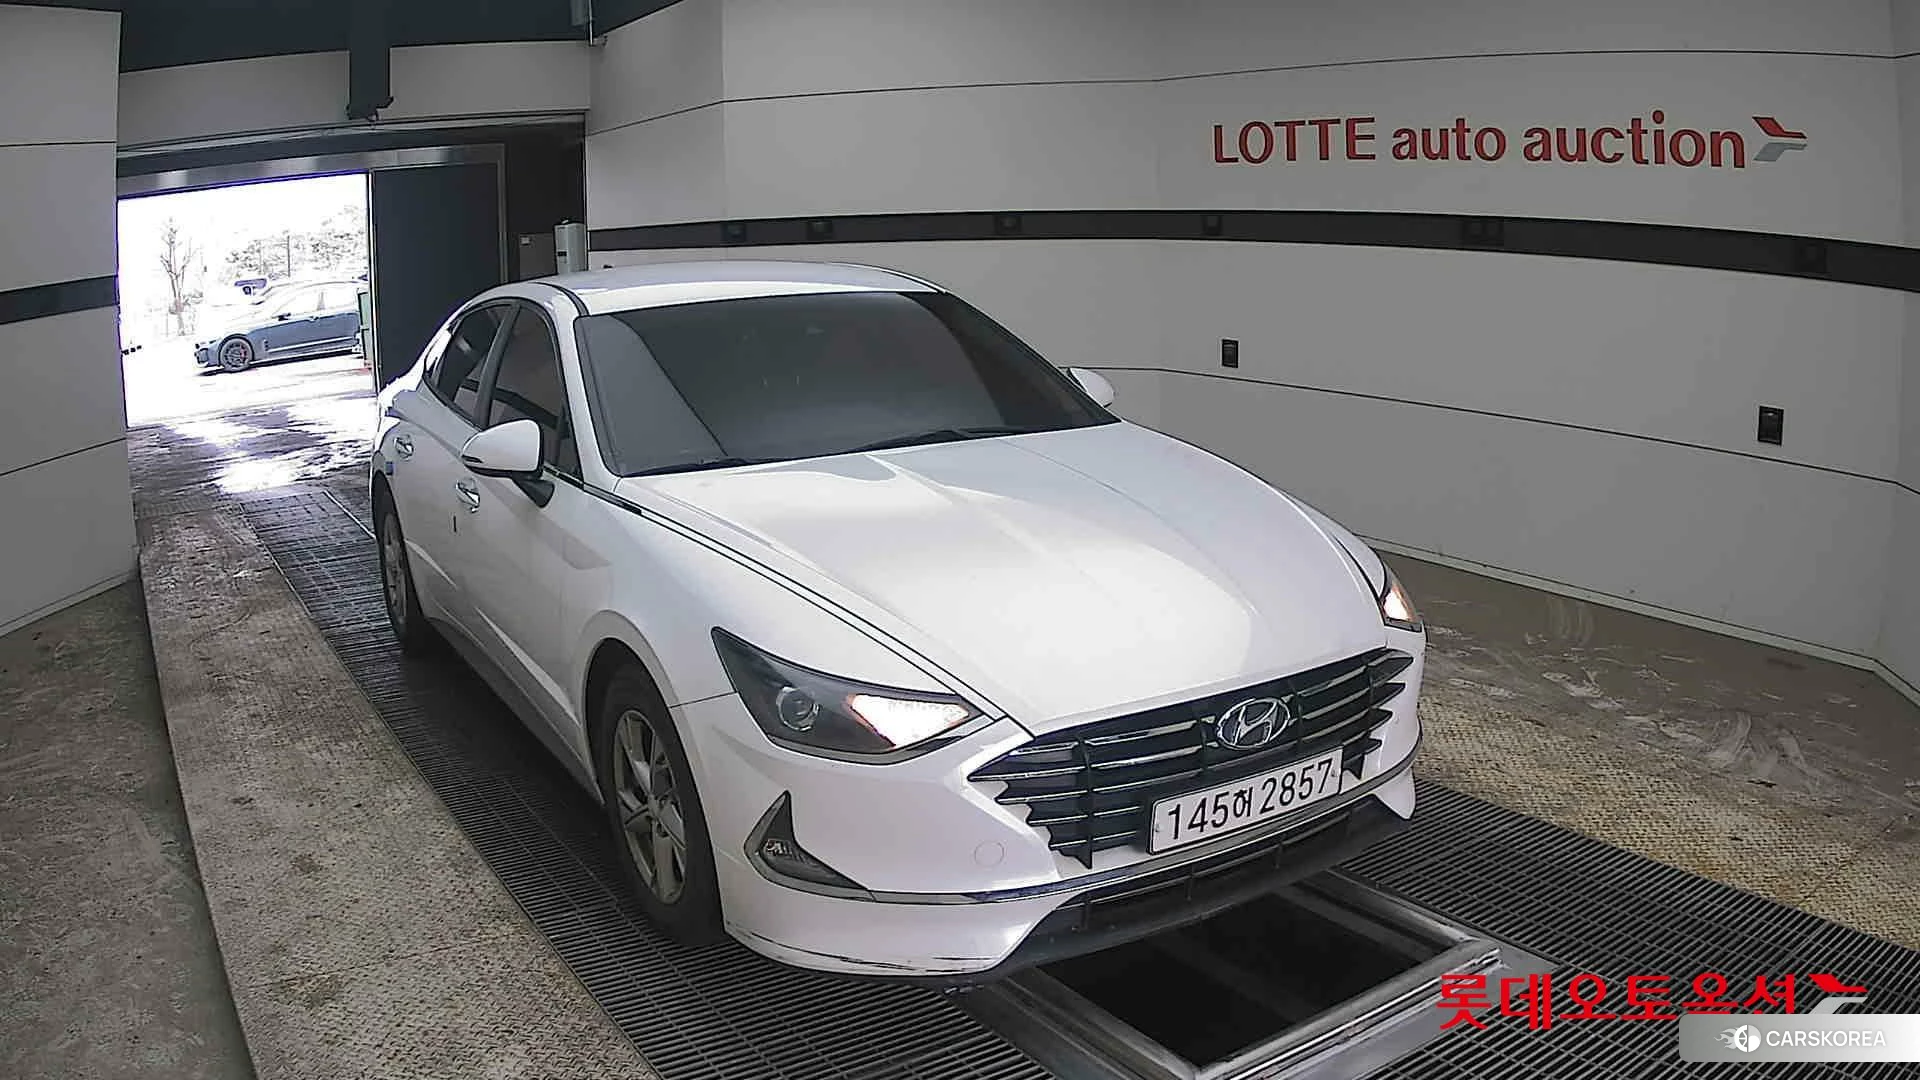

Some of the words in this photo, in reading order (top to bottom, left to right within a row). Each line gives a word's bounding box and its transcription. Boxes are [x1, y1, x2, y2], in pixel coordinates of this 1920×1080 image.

[1213, 117, 1376, 164] LOTTE
[1391, 119, 1507, 162] auto
[1523, 110, 1746, 169] auction
[1168, 786, 1254, 840] 145허
[1259, 758, 1333, 814] 2857
